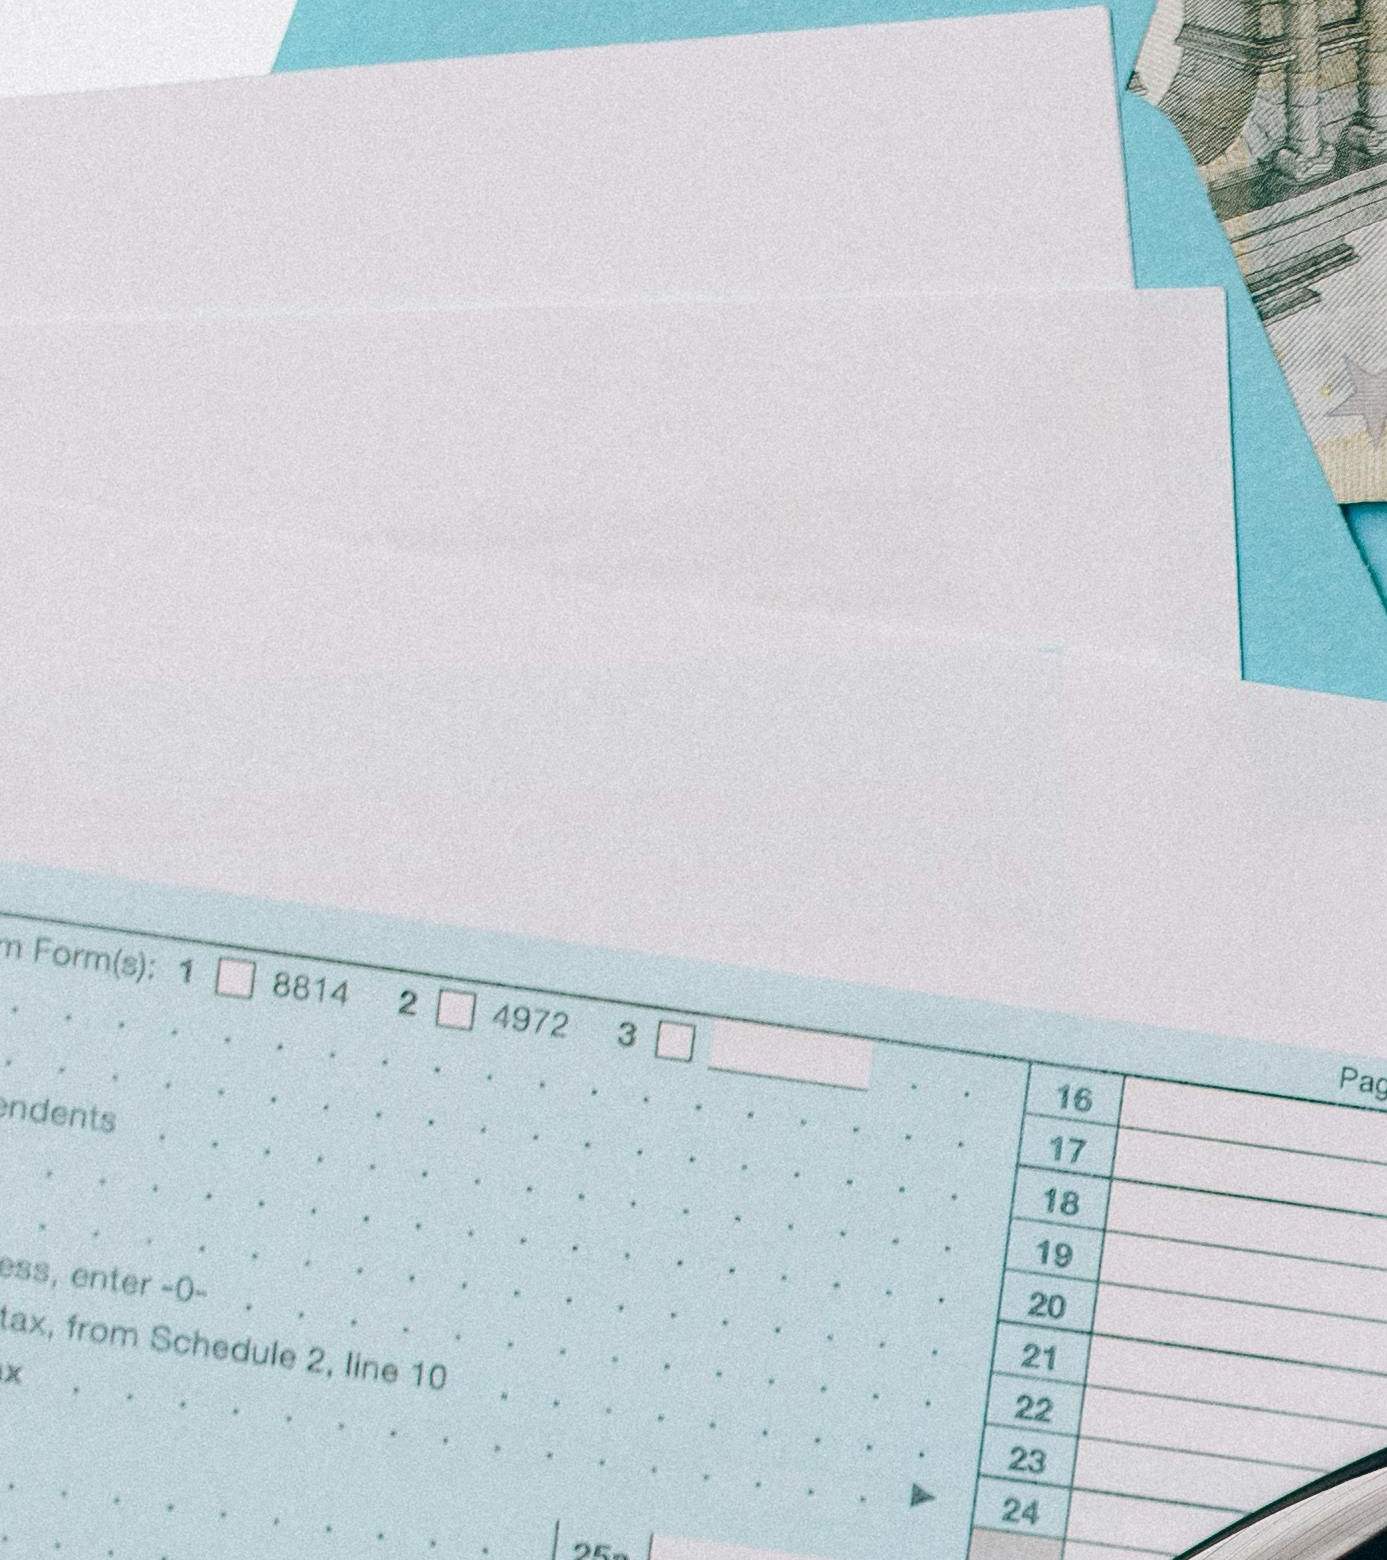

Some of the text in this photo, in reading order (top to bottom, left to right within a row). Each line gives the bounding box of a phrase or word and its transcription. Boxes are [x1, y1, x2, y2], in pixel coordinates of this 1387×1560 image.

[34, 936, 155, 983] Form(s):
[180, 959, 192, 983] 1
[273, 971, 347, 1004] 8814
[399, 990, 417, 1016] 2
[493, 1004, 569, 1037] 4972
[618, 1021, 637, 1048] 3
[1056, 1085, 1093, 1111] 16
[1049, 1136, 1087, 1162] 17
[1043, 1188, 1080, 1215] 18
[1036, 1241, 1073, 1268] 19
[71, 1268, 151, 1295] enter
[162, 1275, 207, 1302] -0-
[1029, 1292, 1066, 1319] 20
[67, 1314, 138, 1347] from
[151, 1325, 297, 1369] Schedule
[306, 1346, 333, 1378] 2,
[346, 1352, 398, 1383] line
[413, 1362, 447, 1390] 10
[1022, 1344, 1057, 1370] 21
[1014, 1395, 1054, 1422] 22
[1008, 1447, 1046, 1474] 23
[1002, 1499, 1040, 1525] 24
